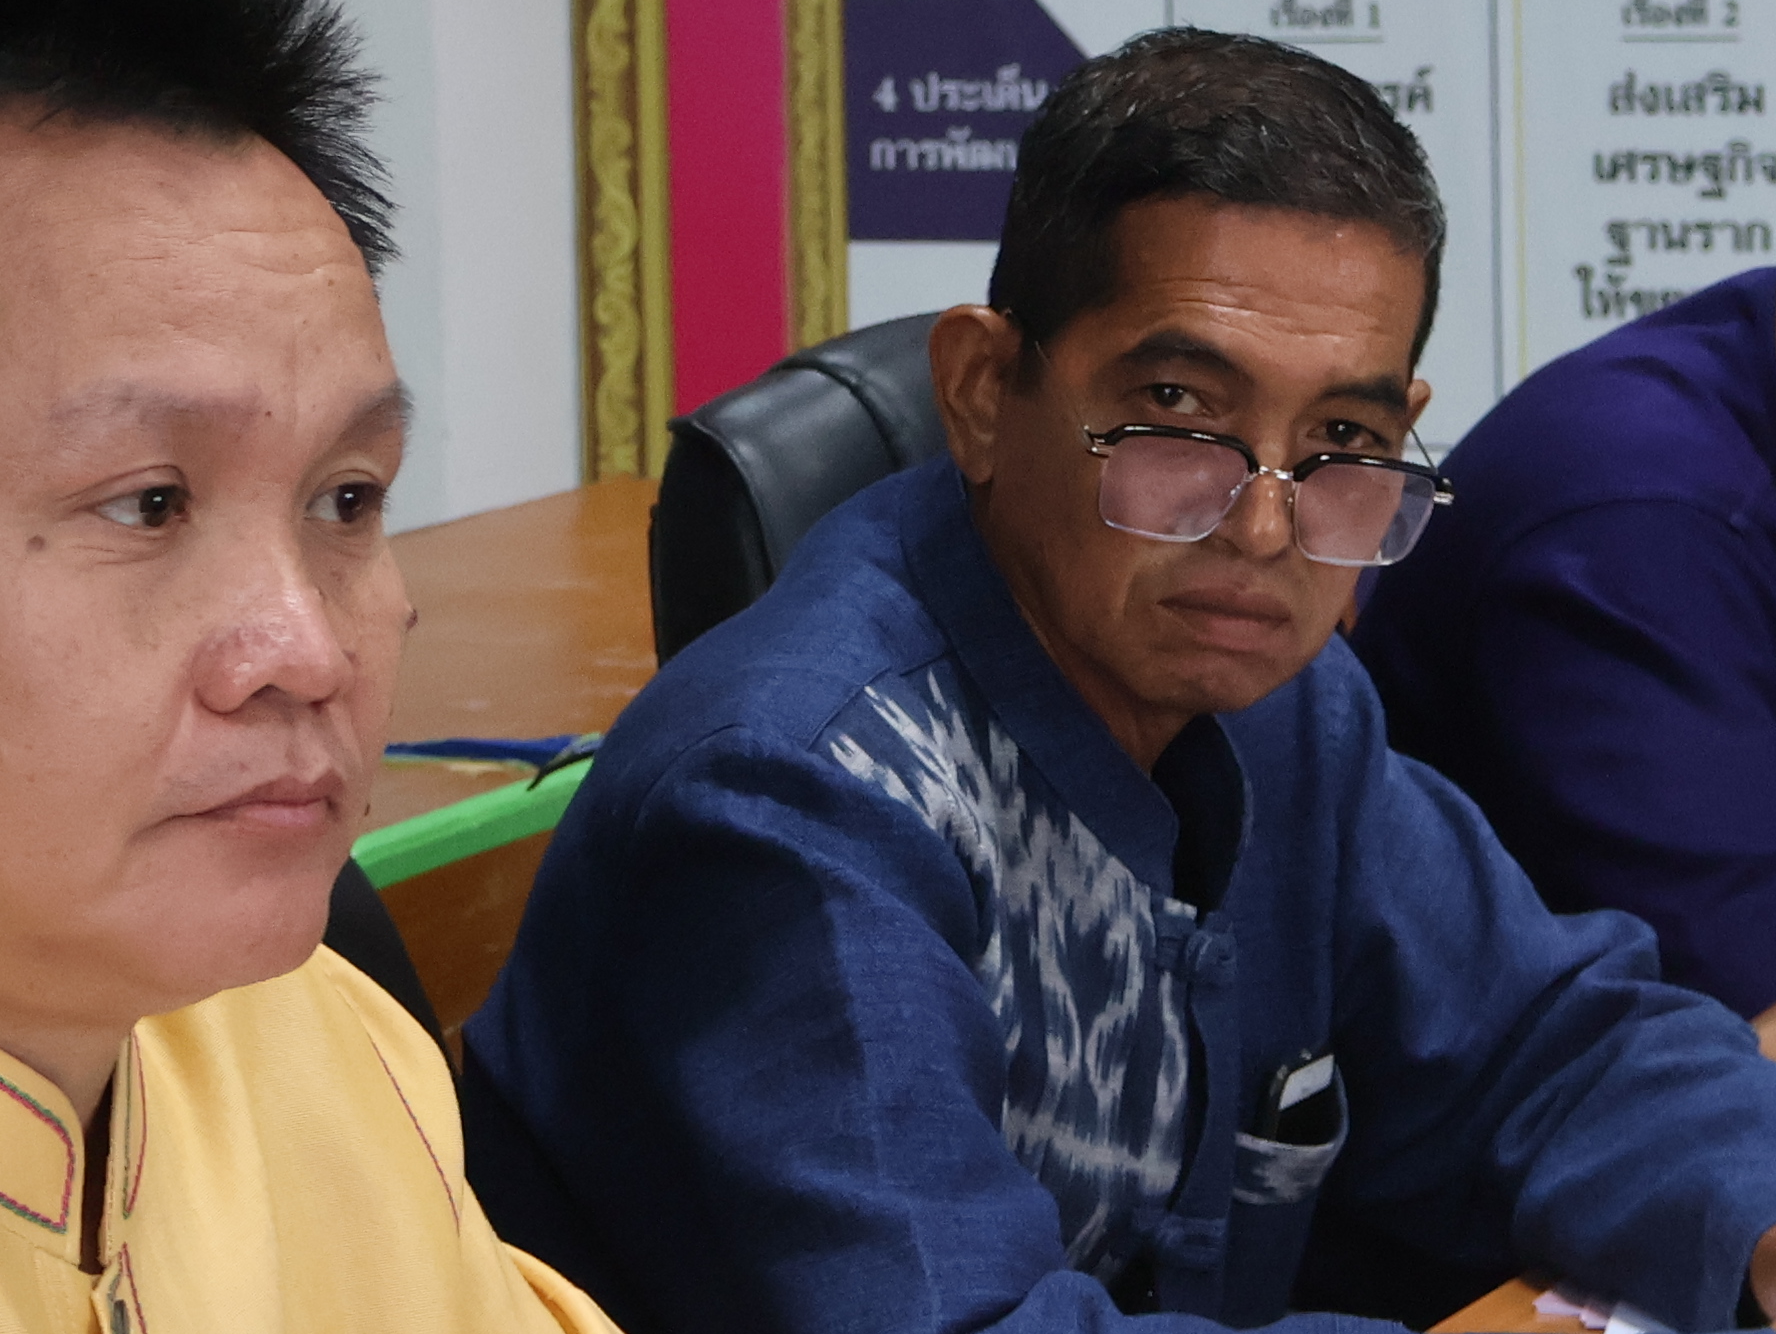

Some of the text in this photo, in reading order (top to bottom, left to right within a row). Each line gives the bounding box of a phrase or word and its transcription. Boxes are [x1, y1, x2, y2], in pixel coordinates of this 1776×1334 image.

[1367, 0, 1381, 29] 1
[871, 74, 900, 113] 4
[1607, 67, 1765, 117] ส่งเสริม
[1605, 218, 1772, 268] ฐานราก
